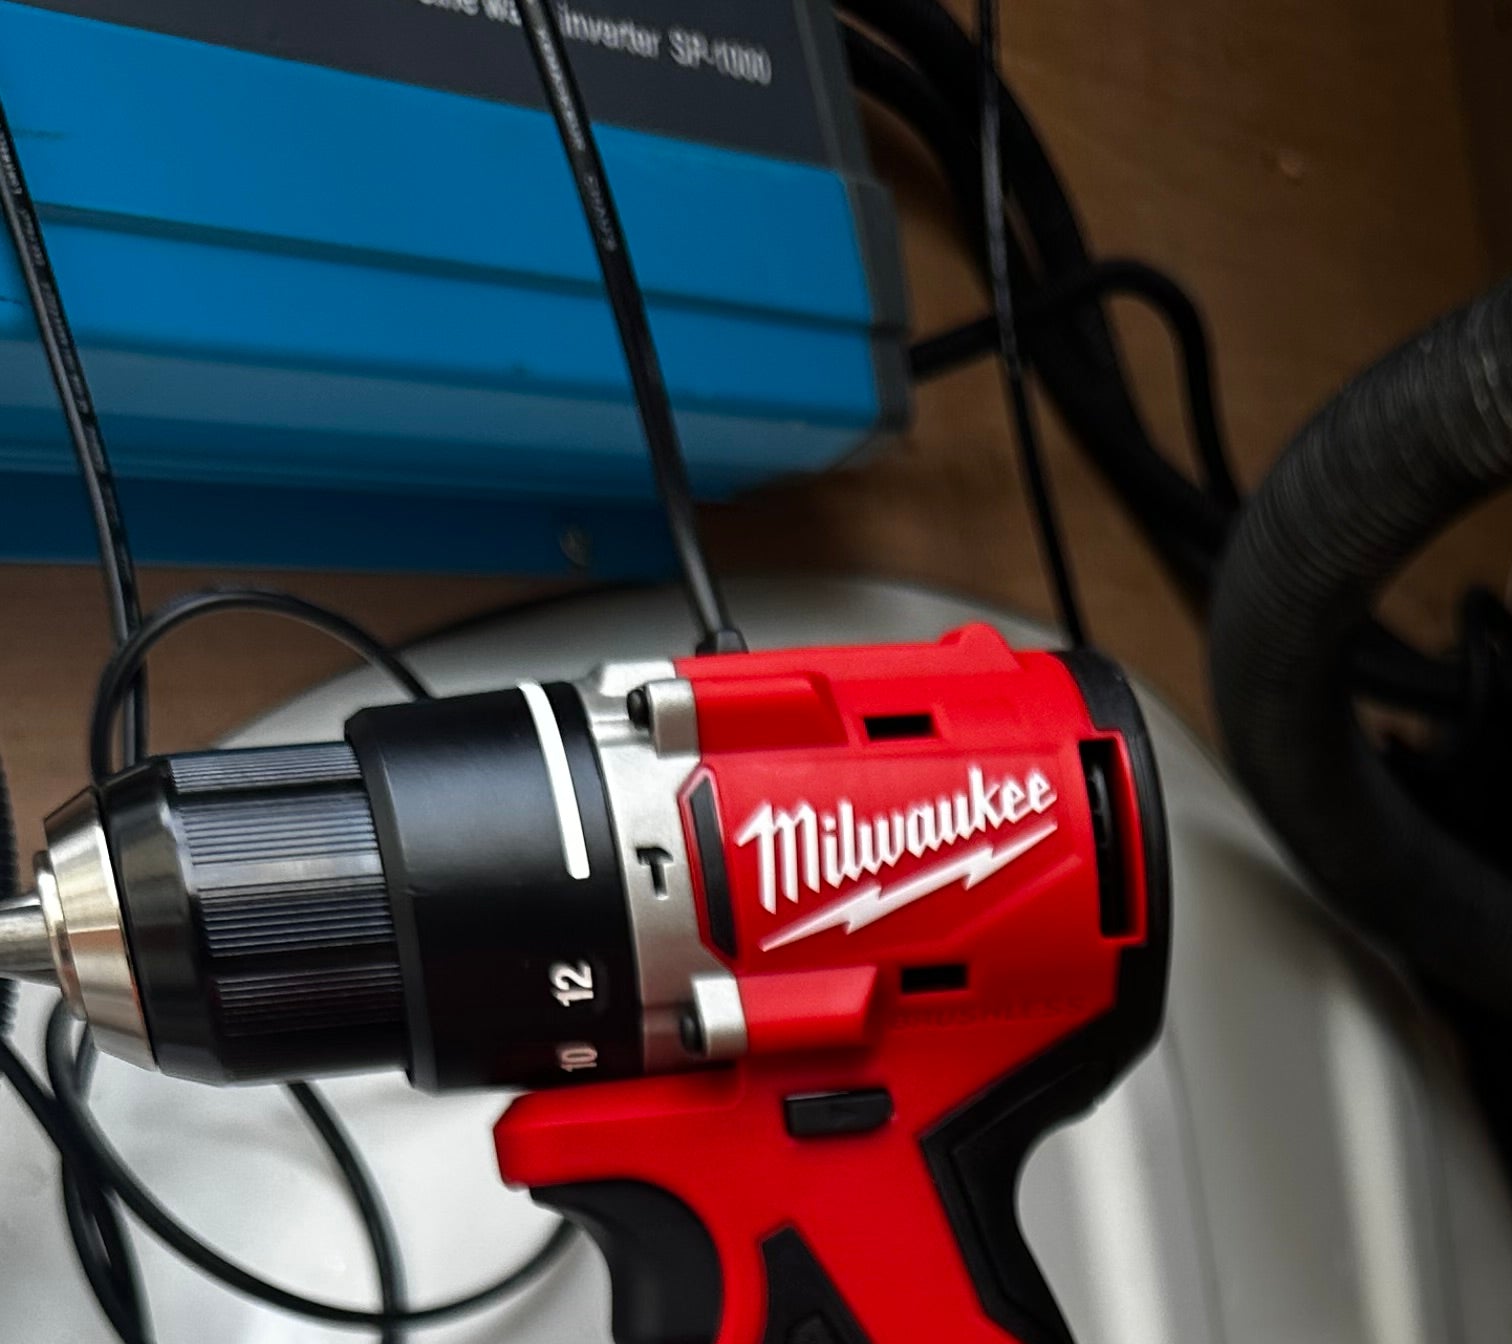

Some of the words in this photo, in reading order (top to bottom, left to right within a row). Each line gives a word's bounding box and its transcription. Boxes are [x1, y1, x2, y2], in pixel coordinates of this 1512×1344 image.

[734, 763, 1057, 915] Milwaukee
[552, 960, 594, 1007] 12
[558, 1047, 598, 1072] 10
